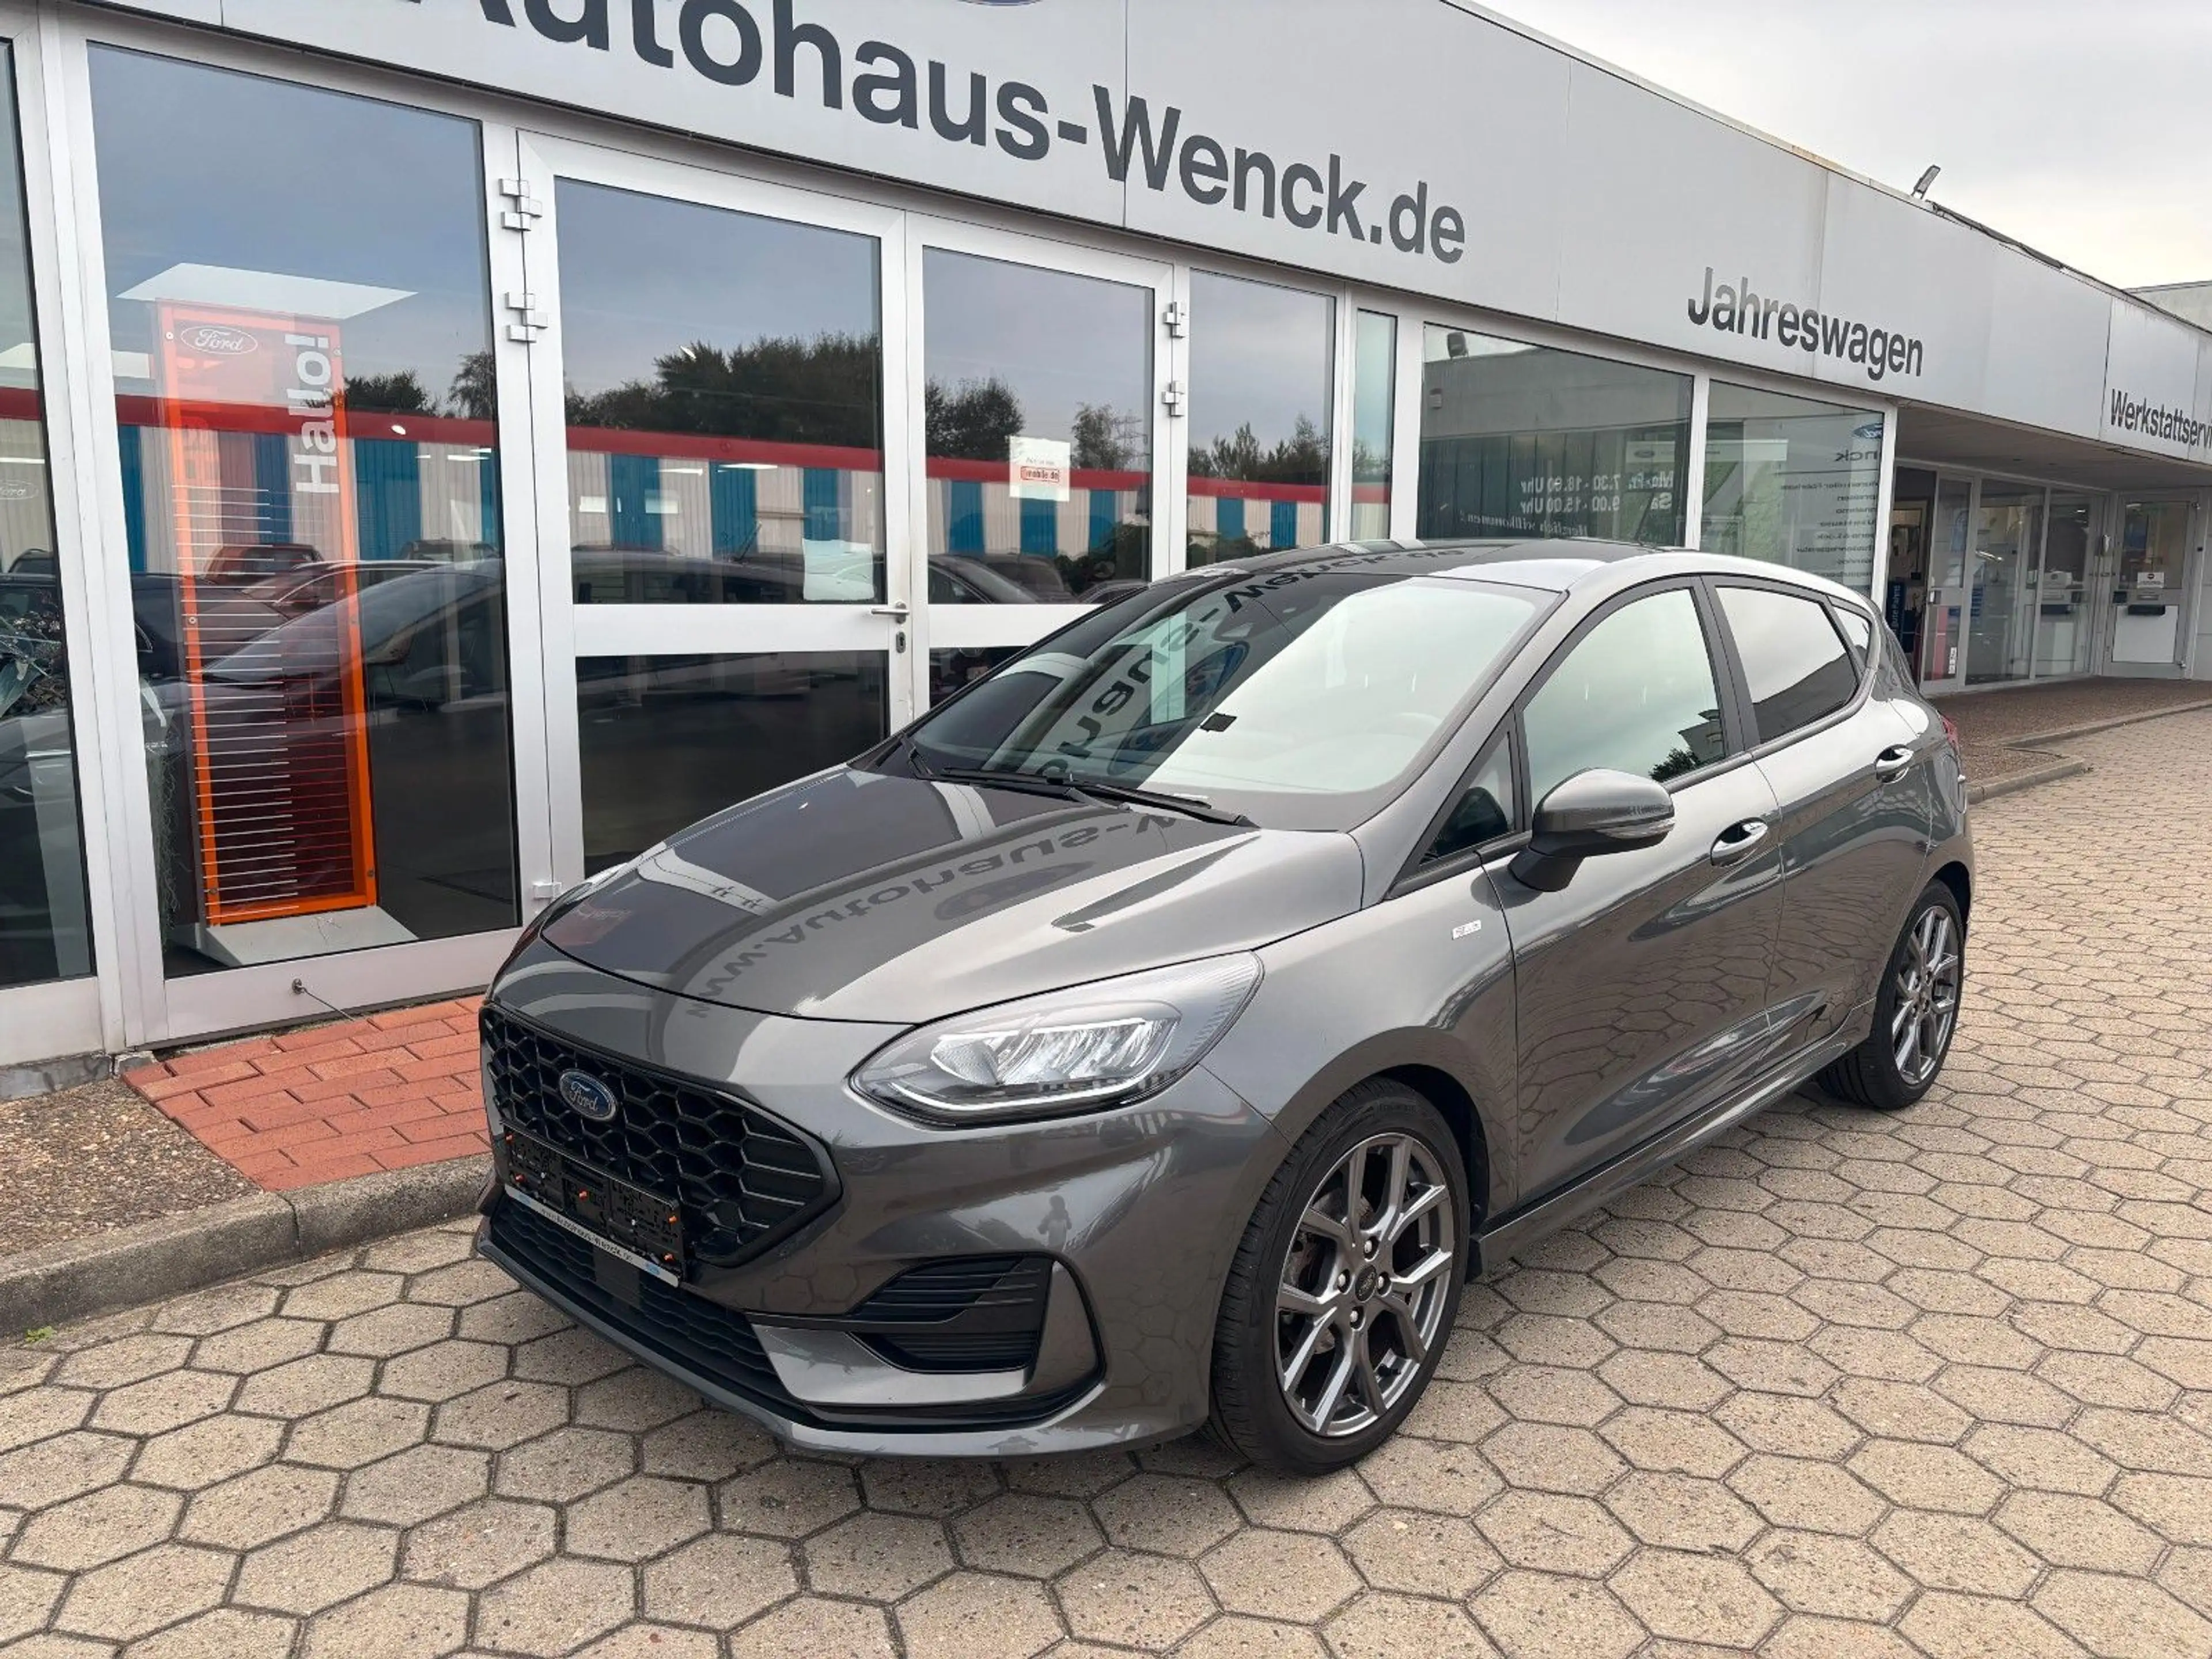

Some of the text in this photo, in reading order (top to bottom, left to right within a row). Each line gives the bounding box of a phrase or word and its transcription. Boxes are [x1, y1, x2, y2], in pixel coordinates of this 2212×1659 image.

[406, 0, 1465, 264] utohaus-Wenck.de
[1688, 266, 1923, 381] Jahreswagen
[285, 334, 339, 493] Hallo!
[569, 1081, 599, 1111] Ford
